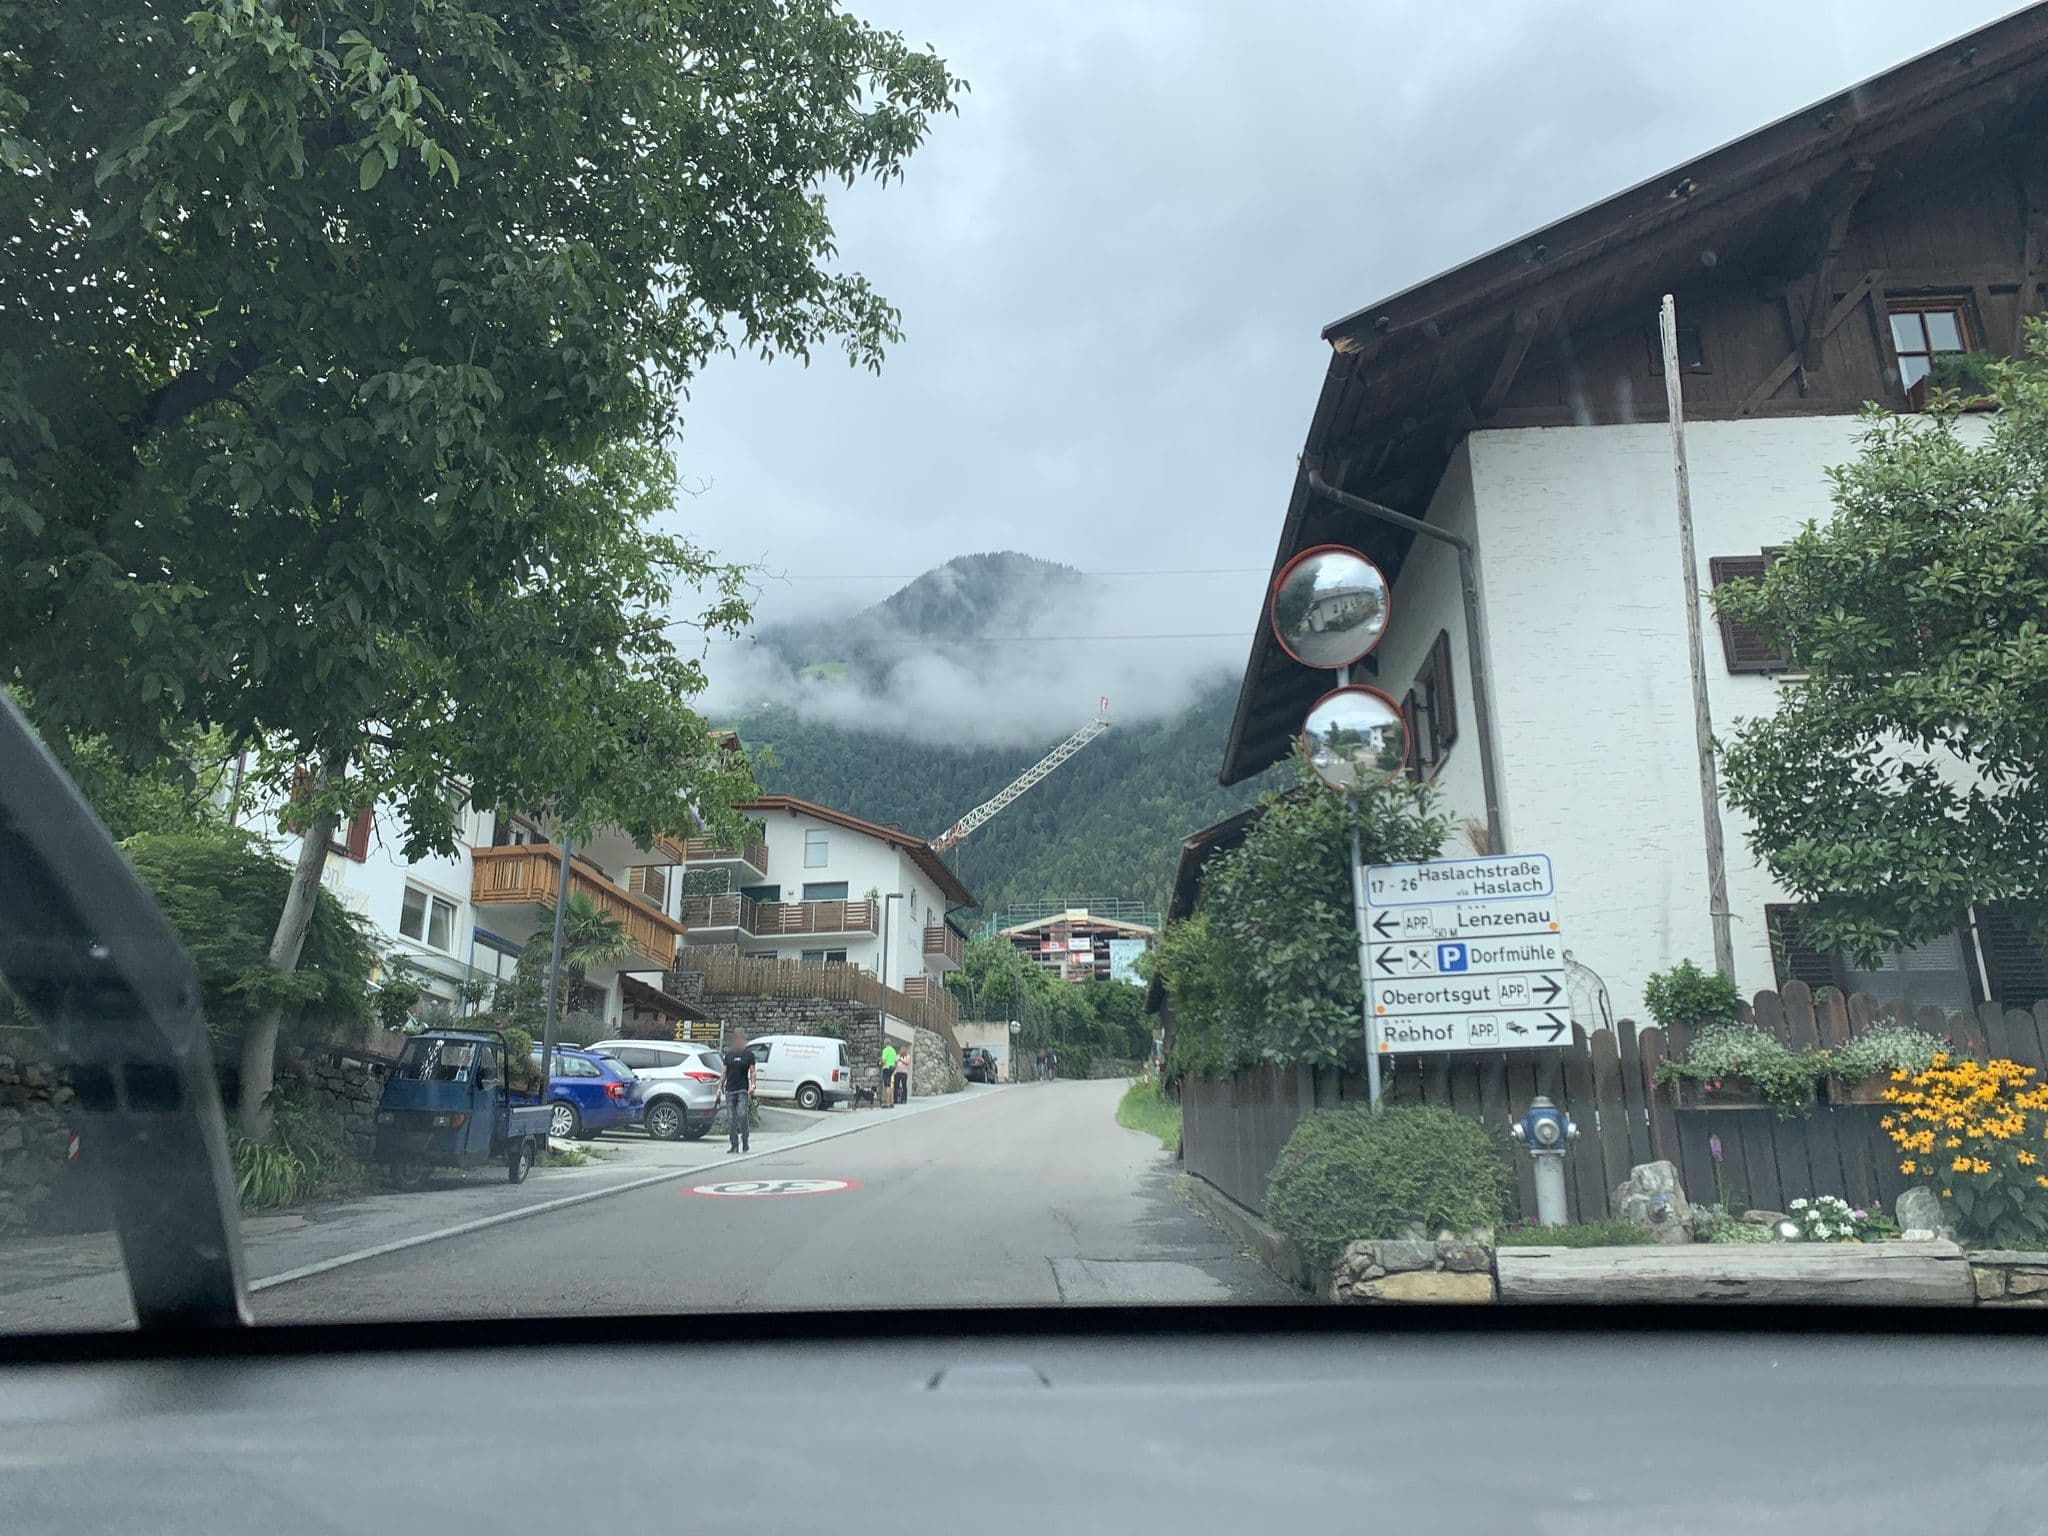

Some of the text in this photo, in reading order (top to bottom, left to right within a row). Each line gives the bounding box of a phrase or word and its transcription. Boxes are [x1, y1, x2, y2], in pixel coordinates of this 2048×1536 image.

[1418, 862, 1541, 882] Haslachstraße
[1371, 880, 1384, 894] 17
[1401, 878, 1418, 892] 26
[1473, 878, 1543, 895] Haslach
[1457, 911, 1551, 928] Lenzenau
[1471, 944, 1556, 964] Dorfmühle
[1382, 984, 1527, 1005] Oberortsgut APP.
[1384, 1024, 1454, 1041] Rebhof
